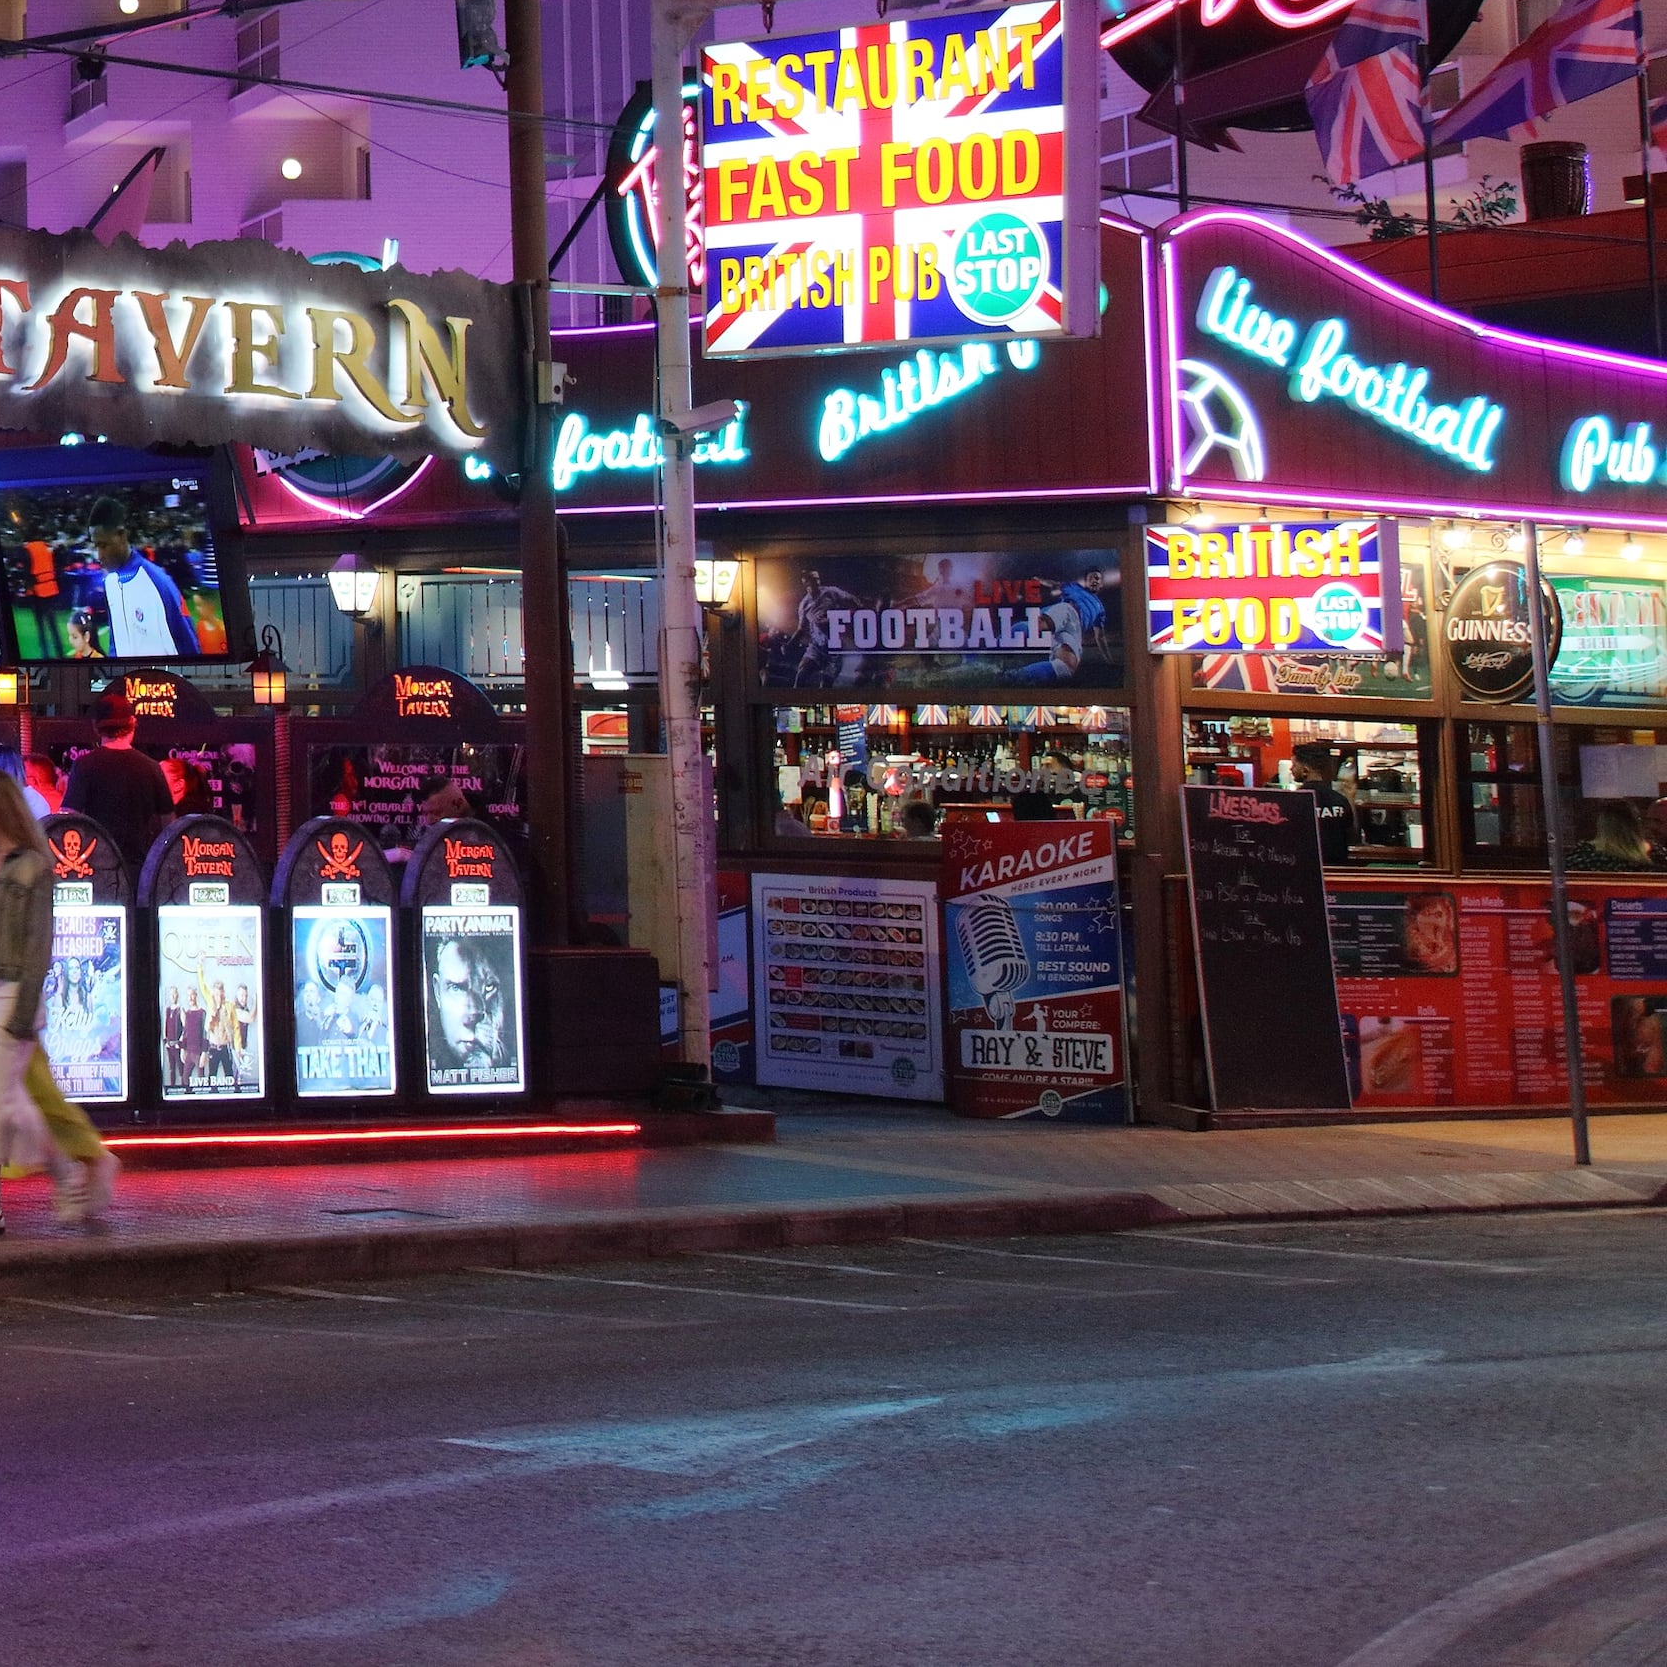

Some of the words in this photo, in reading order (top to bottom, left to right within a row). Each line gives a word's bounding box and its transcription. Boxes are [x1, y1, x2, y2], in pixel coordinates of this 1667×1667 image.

[712, 23, 1043, 126] RESTAURANT
[719, 147, 860, 222] FAST
[881, 129, 1041, 208] FOOD
[965, 228, 1029, 257] LAST
[721, 249, 854, 315] BRITISH
[869, 242, 941, 305] PUB
[956, 258, 1040, 294] STOP
[1289, 319, 1504, 472] football
[1167, 529, 1362, 580] BRITISH
[975, 579, 1043, 604] LIVE
[1320, 595, 1357, 612] LAST
[827, 607, 1053, 650] FOOTBALL
[1170, 597, 1302, 646] FOOD
[1315, 612, 1363, 630] STOP
[432, 764, 446, 775] TO
[451, 764, 470, 775] THE
[364, 776, 421, 791] MORGAN
[182, 835, 235, 858] MORGAN
[444, 838, 495, 860] MORGAN
[184, 856, 234, 876] TAVERN
[446, 859, 493, 878] TAVERN
[960, 831, 1094, 891] KARAOKE
[1011, 881, 1037, 893] HERE
[1039, 873, 1070, 887] EVERY
[1072, 866, 1103, 879] NIGHT
[808, 885, 837, 895] British
[838, 887, 878, 898] Products
[1461, 896, 1481, 908] Main
[1483, 897, 1504, 908] Meals
[1611, 900, 1644, 912] Desserts
[53, 916, 96, 935] ECADES
[425, 916, 466, 932] PARTY
[467, 915, 514, 931] ANIMAL
[1033, 914, 1063, 923] SONGS
[1035, 931, 1059, 942] 8:30
[1061, 932, 1079, 942] PM
[52, 937, 104, 957] NLEASHED
[1036, 943, 1052, 952] TILL
[1054, 943, 1074, 952] LATE
[1037, 961, 1067, 972] BEST
[1068, 961, 1110, 973] SOUND
[1037, 973, 1046, 982] IN
[1047, 973, 1094, 983] BENIDORM
[1052, 1009, 1079, 1019] YOUR
[1417, 1005, 1437, 1016] Rolls
[297, 1046, 343, 1079] TAKE
[346, 1045, 389, 1078] THAT
[971, 1035, 1015, 1065] RAY
[1025, 1035, 1042, 1067] &
[1053, 1037, 1107, 1072] STEVE
[189, 1076, 209, 1087] LIVE
[210, 1075, 235, 1087] BAND
[430, 1069, 467, 1084] MATT
[469, 1067, 517, 1082] FISHER
